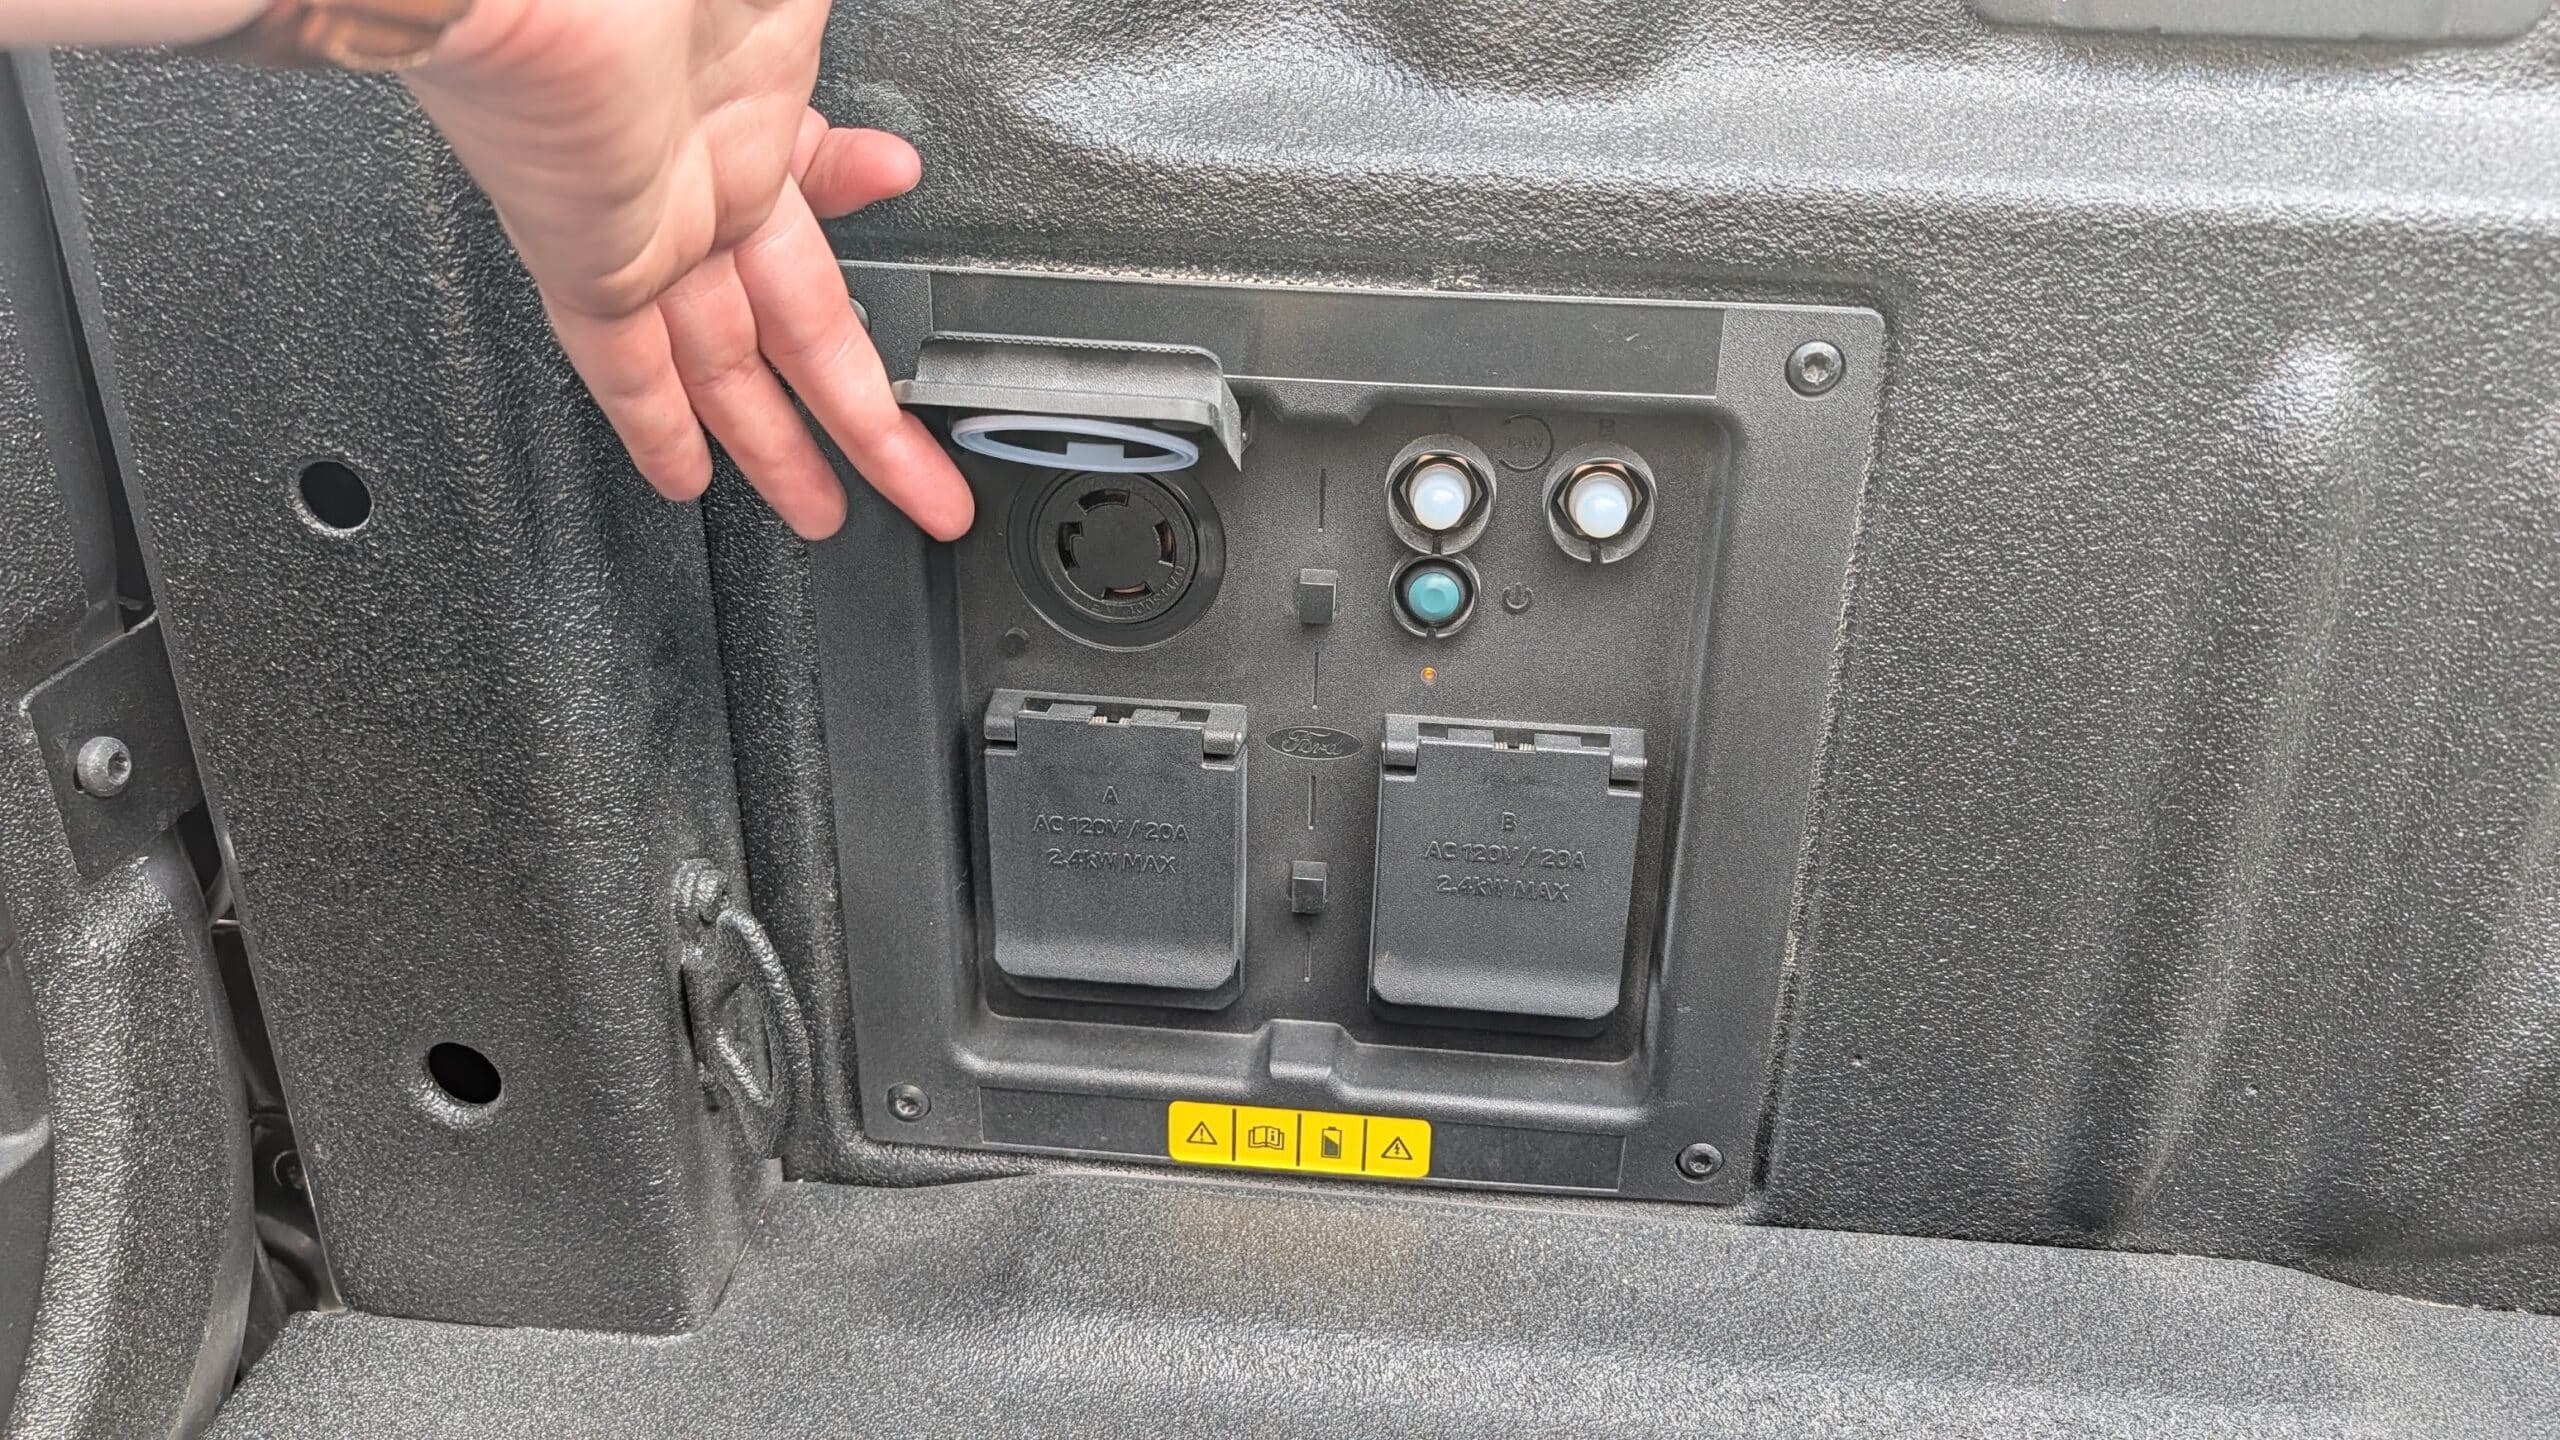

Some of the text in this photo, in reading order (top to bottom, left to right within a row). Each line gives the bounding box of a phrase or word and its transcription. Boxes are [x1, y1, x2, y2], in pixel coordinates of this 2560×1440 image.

[1281, 728, 1343, 755] Ford
[1102, 785, 1121, 804] A
[1032, 813, 1192, 845] AC 120V / 20A
[1501, 810, 1519, 832] B
[1122, 852, 1177, 874] MAX
[1424, 840, 1587, 870] AC 120V / 20A
[1513, 878, 1570, 902] MAX
